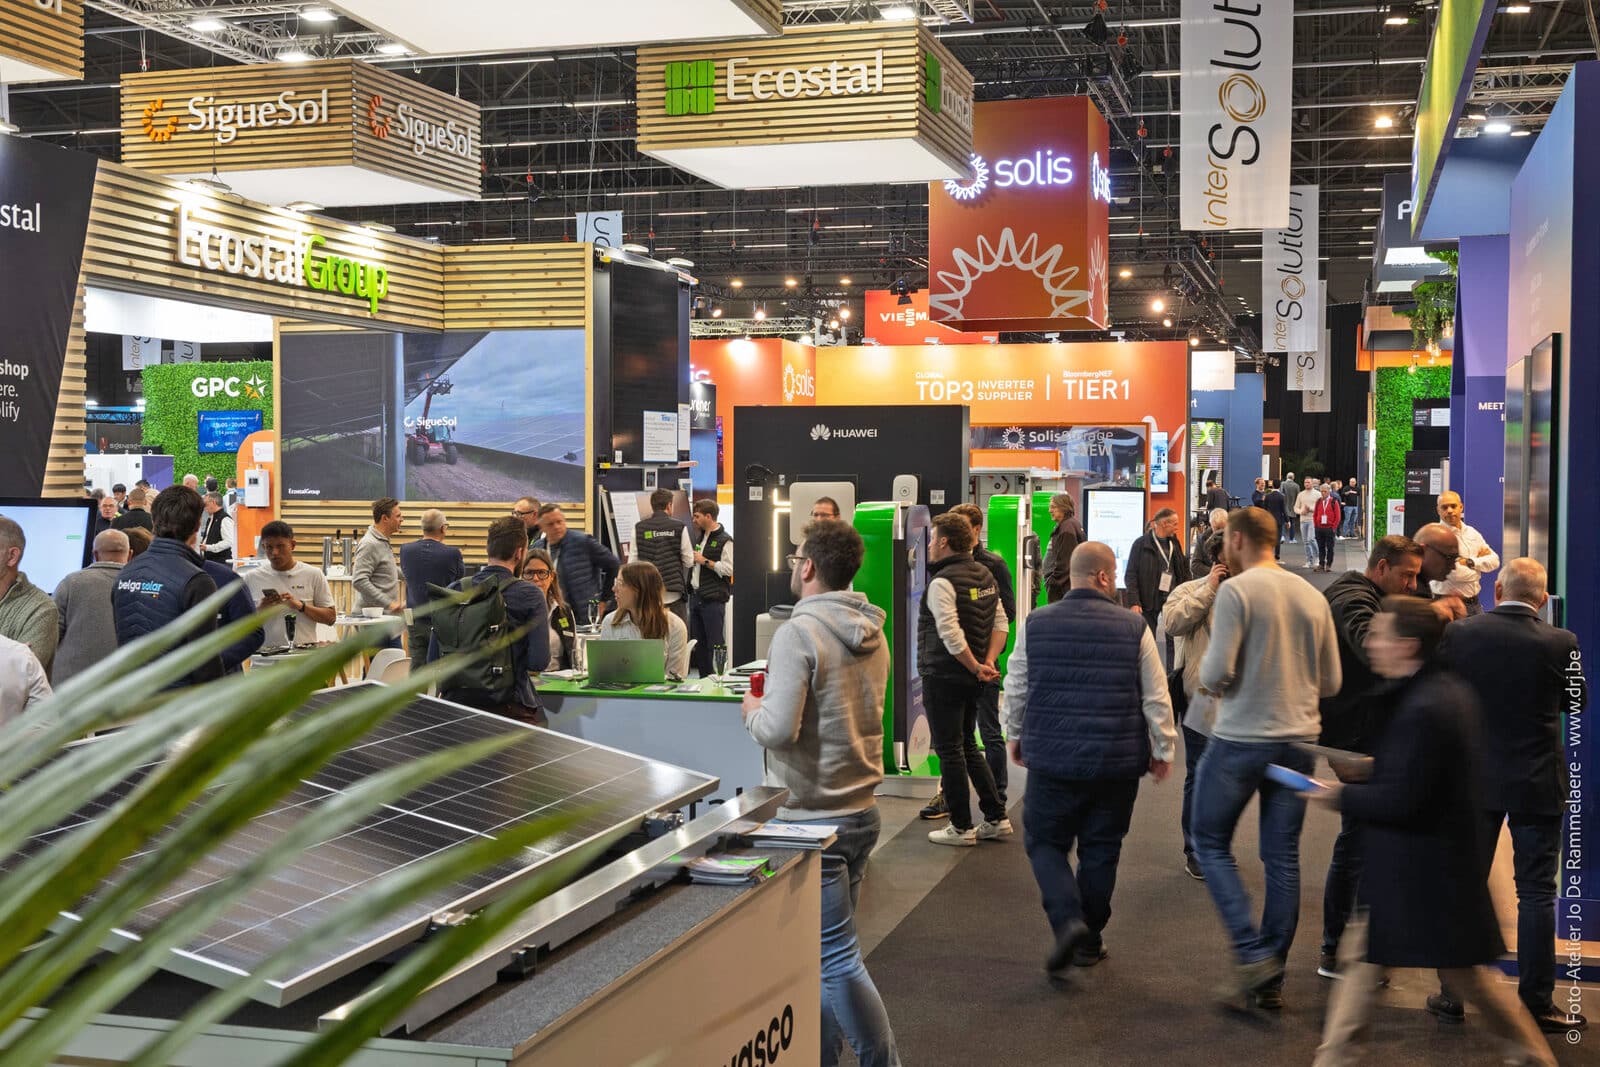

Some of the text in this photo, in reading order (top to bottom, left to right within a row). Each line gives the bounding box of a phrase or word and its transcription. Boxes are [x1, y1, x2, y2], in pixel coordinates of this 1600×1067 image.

[726, 48, 884, 102] Ecostal
[188, 88, 328, 143] SigueSol
[396, 103, 472, 158] SigueSol
[994, 150, 1072, 187] solis
[880, 309, 930, 327] VIESSM
[916, 371, 944, 379] GLOBAL
[1063, 370, 1113, 379] BloombergNEF
[192, 376, 241, 398] GPC
[796, 369, 815, 398] solis
[978, 379, 1034, 389] INVERTER
[977, 391, 1033, 401] SUPPLIER
[0, 401, 20, 422] lify
[1478, 402, 1505, 410] MEET
[416, 416, 457, 430] SigueSol
[833, 428, 878, 438] HUAWEI
[652, 529, 675, 538] Ecostal
